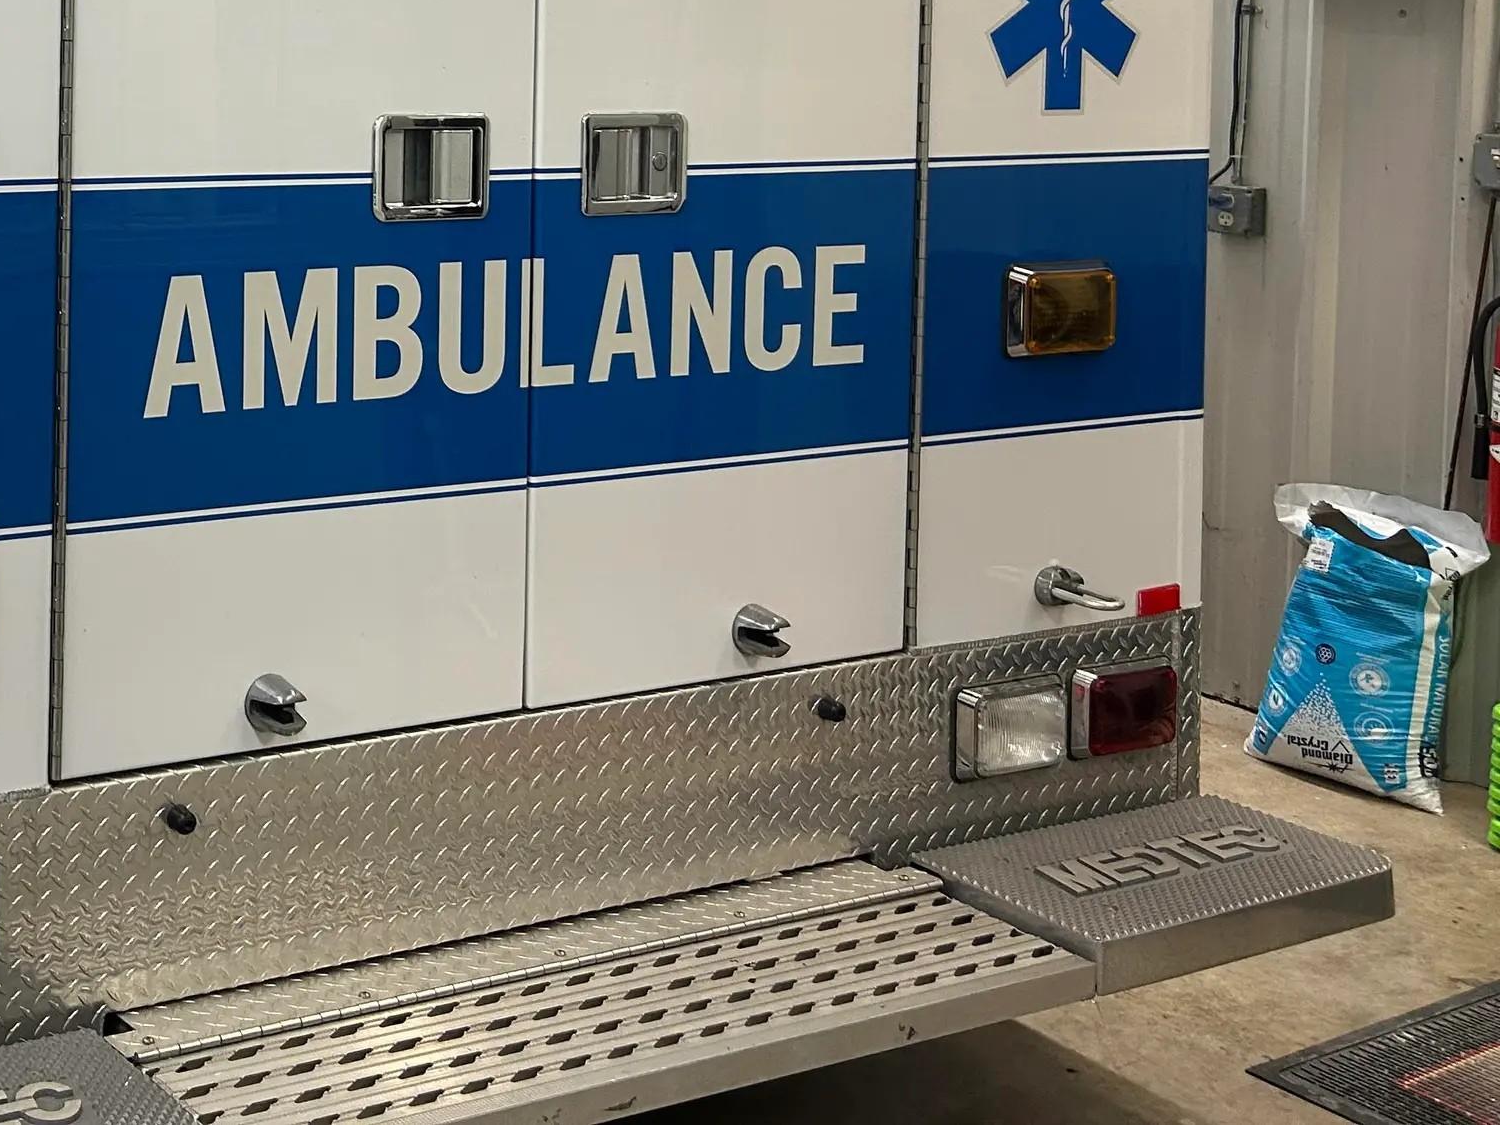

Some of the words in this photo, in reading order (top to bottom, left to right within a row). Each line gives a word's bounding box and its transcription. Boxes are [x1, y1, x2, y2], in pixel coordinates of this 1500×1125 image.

[143, 244, 866, 420] AMBULANCE
[1301, 746, 1353, 765] Diamond
[1034, 825, 1281, 897] MEDTEC
